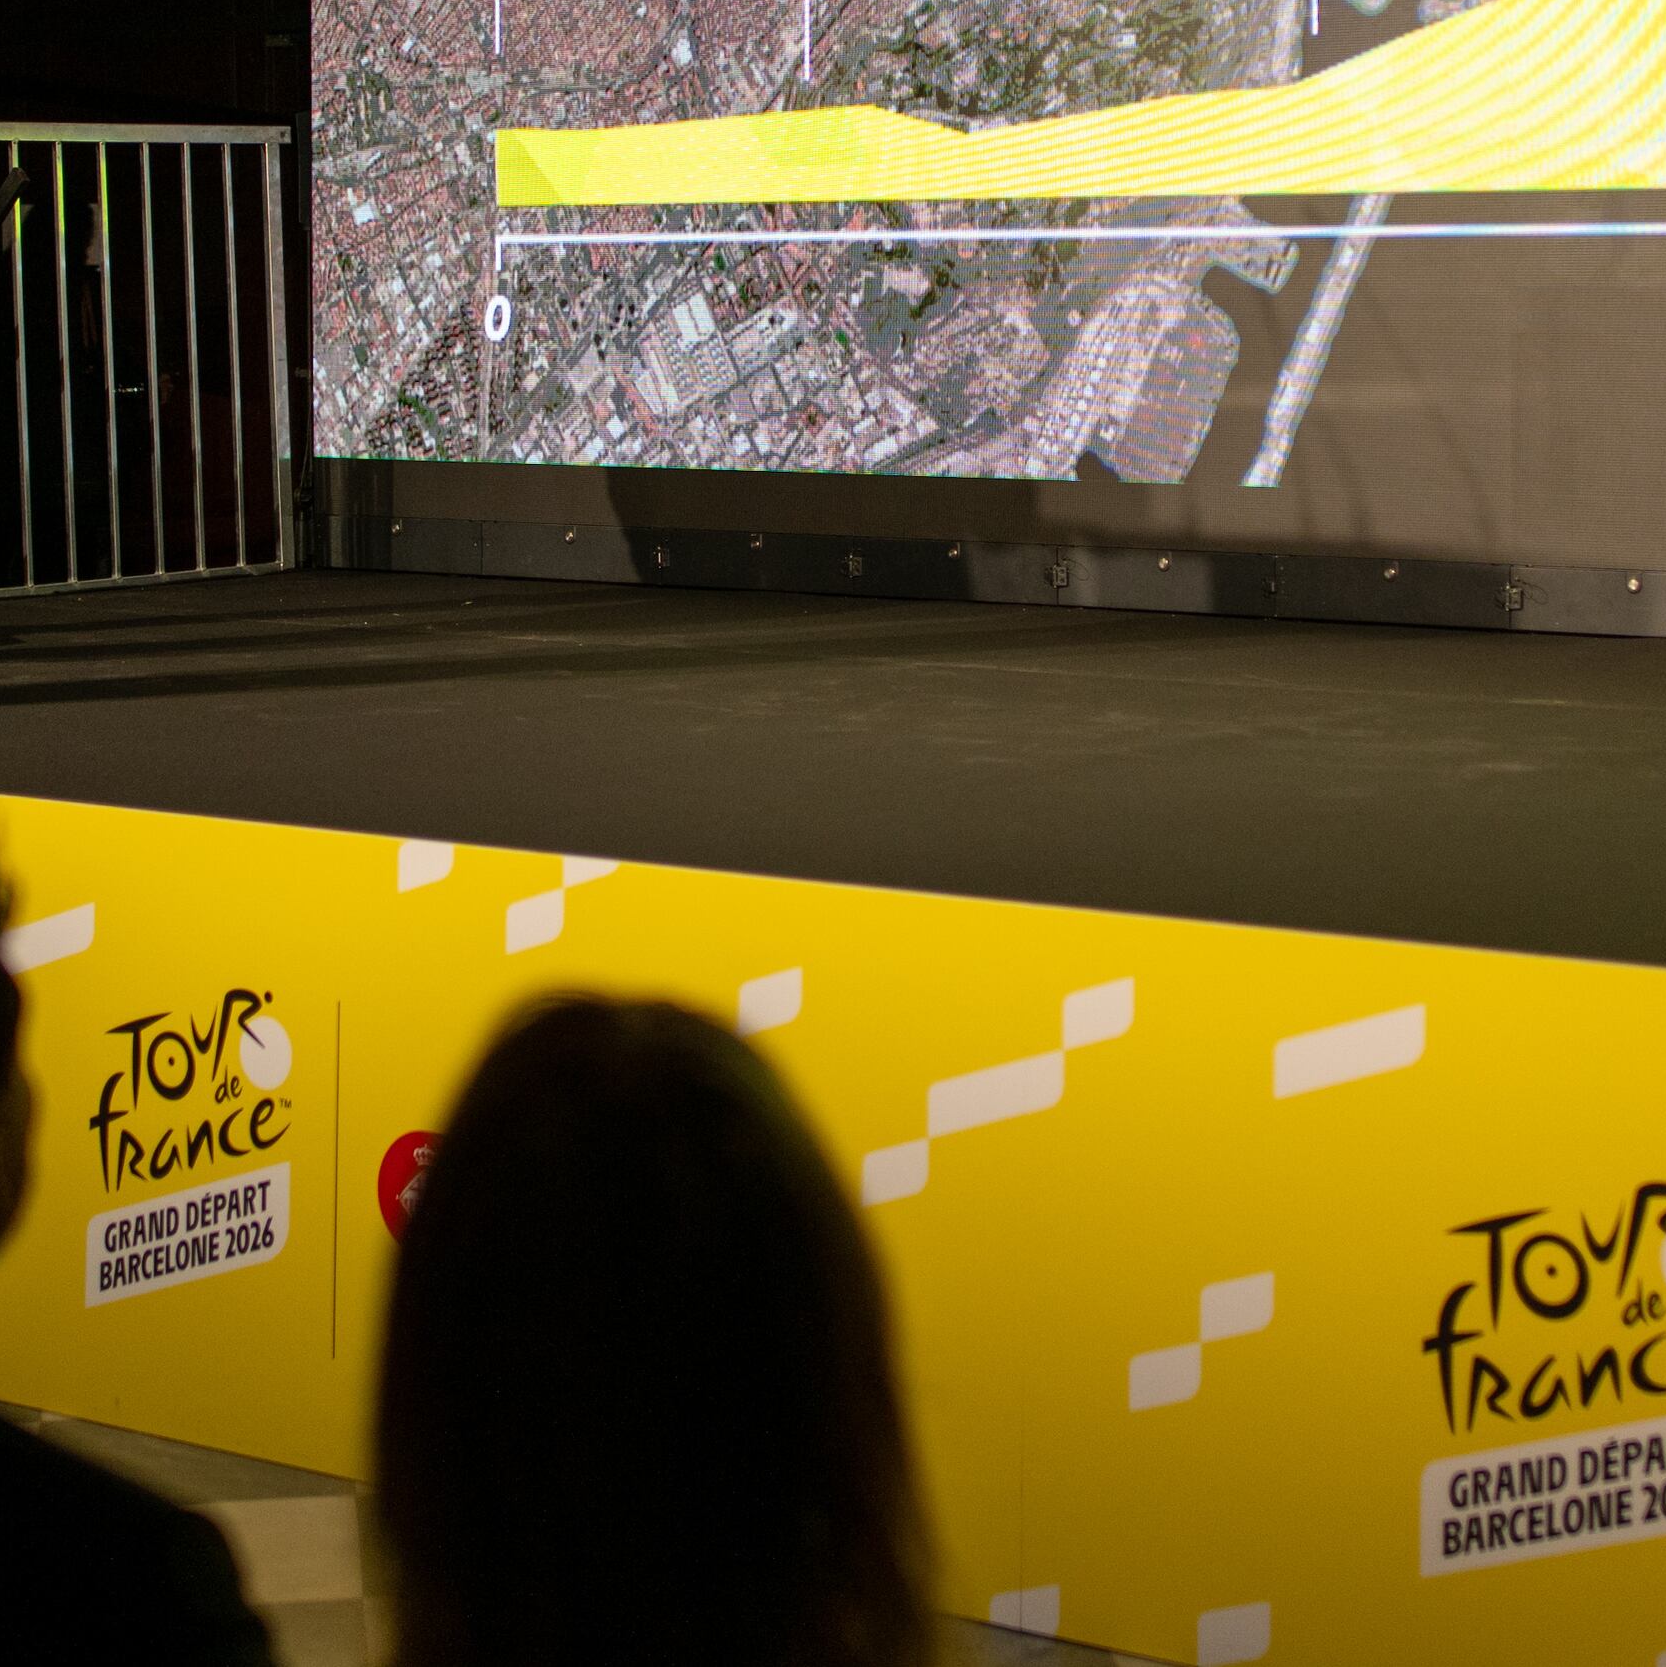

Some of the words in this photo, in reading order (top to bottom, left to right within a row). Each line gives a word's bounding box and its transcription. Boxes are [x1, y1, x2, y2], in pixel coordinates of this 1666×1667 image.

[484, 295, 511, 342] 0
[215, 1065, 243, 1104] de
[104, 1207, 179, 1253] GRAND
[185, 1180, 271, 1232] DÉPART
[100, 1237, 220, 1291] BARCELONE
[224, 1218, 274, 1257] 2026
[1623, 1280, 1666, 1328] de
[1449, 1447, 1570, 1510] GRAND
[1442, 1488, 1633, 1559] BARCELONE
